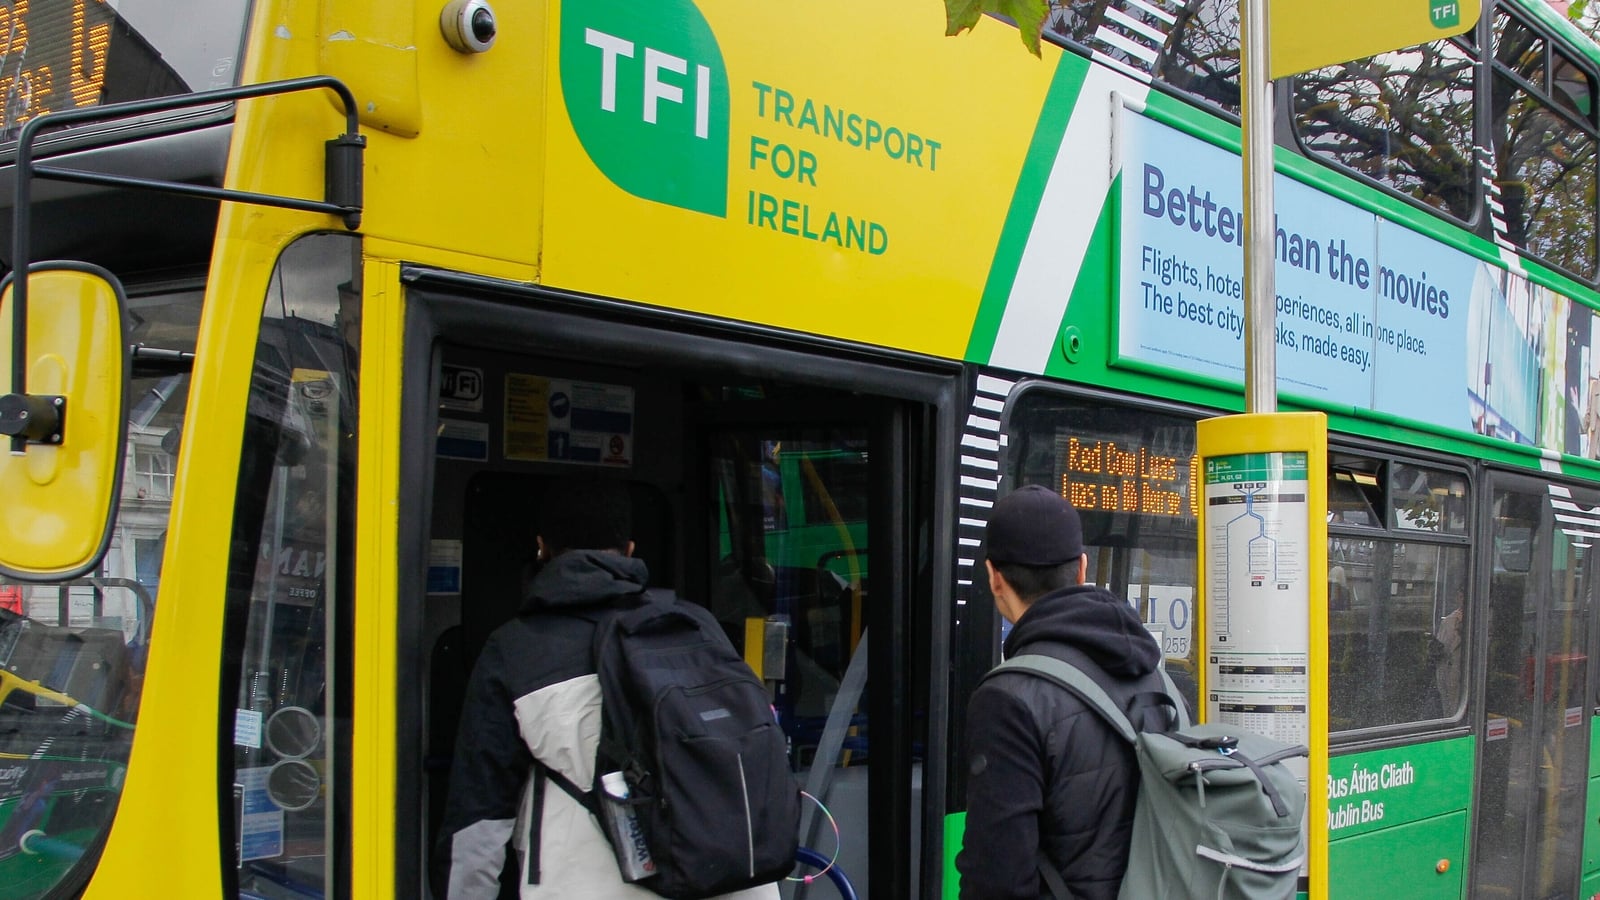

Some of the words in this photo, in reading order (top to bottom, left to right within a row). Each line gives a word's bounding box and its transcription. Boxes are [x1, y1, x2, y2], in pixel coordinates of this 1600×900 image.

[1432, 3, 1456, 20] TFI
[584, 27, 711, 139] TFI
[752, 80, 942, 171] TRANSPORT
[749, 135, 818, 187] FOR
[747, 190, 888, 256] IRELAND
[1275, 213, 1320, 274] han
[1327, 238, 1370, 290] the
[1377, 264, 1450, 320] movies
[1140, 281, 1173, 315] The
[1177, 292, 1214, 326] best
[1301, 334, 1338, 360] made
[1341, 345, 1372, 372] easy.
[1141, 245, 1202, 292] Flights,
[1346, 316, 1359, 335] all
[1362, 316, 1373, 339] in
[1376, 325, 1394, 344] one
[1396, 329, 1427, 356] place.
[1069, 437, 1101, 472] Red
[1106, 442, 1136, 477] Cow
[1140, 447, 1176, 480] Luas
[1327, 774, 1348, 800] Bus
[1349, 762, 1378, 795] Átha
[1380, 761, 1414, 789] Cliath
[1361, 799, 1384, 823] Bus
